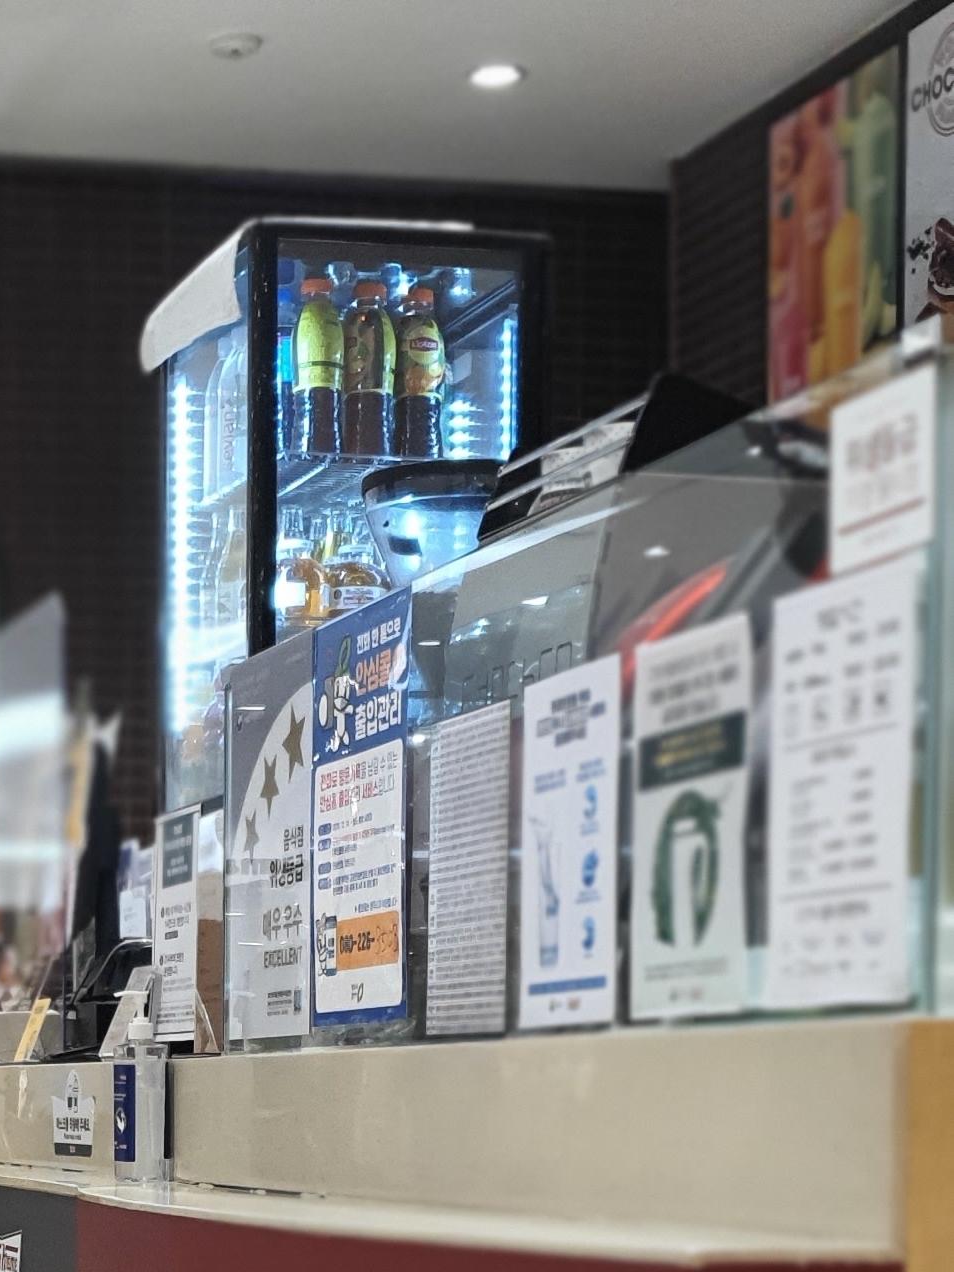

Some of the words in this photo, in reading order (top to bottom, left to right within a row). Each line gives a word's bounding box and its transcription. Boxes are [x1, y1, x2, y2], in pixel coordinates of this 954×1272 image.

[354, 688, 402, 741] 출입관리
[283, 823, 304, 853] 음식점
[262, 903, 303, 941] 매우우수
[263, 945, 303, 969] EXCELLENT
